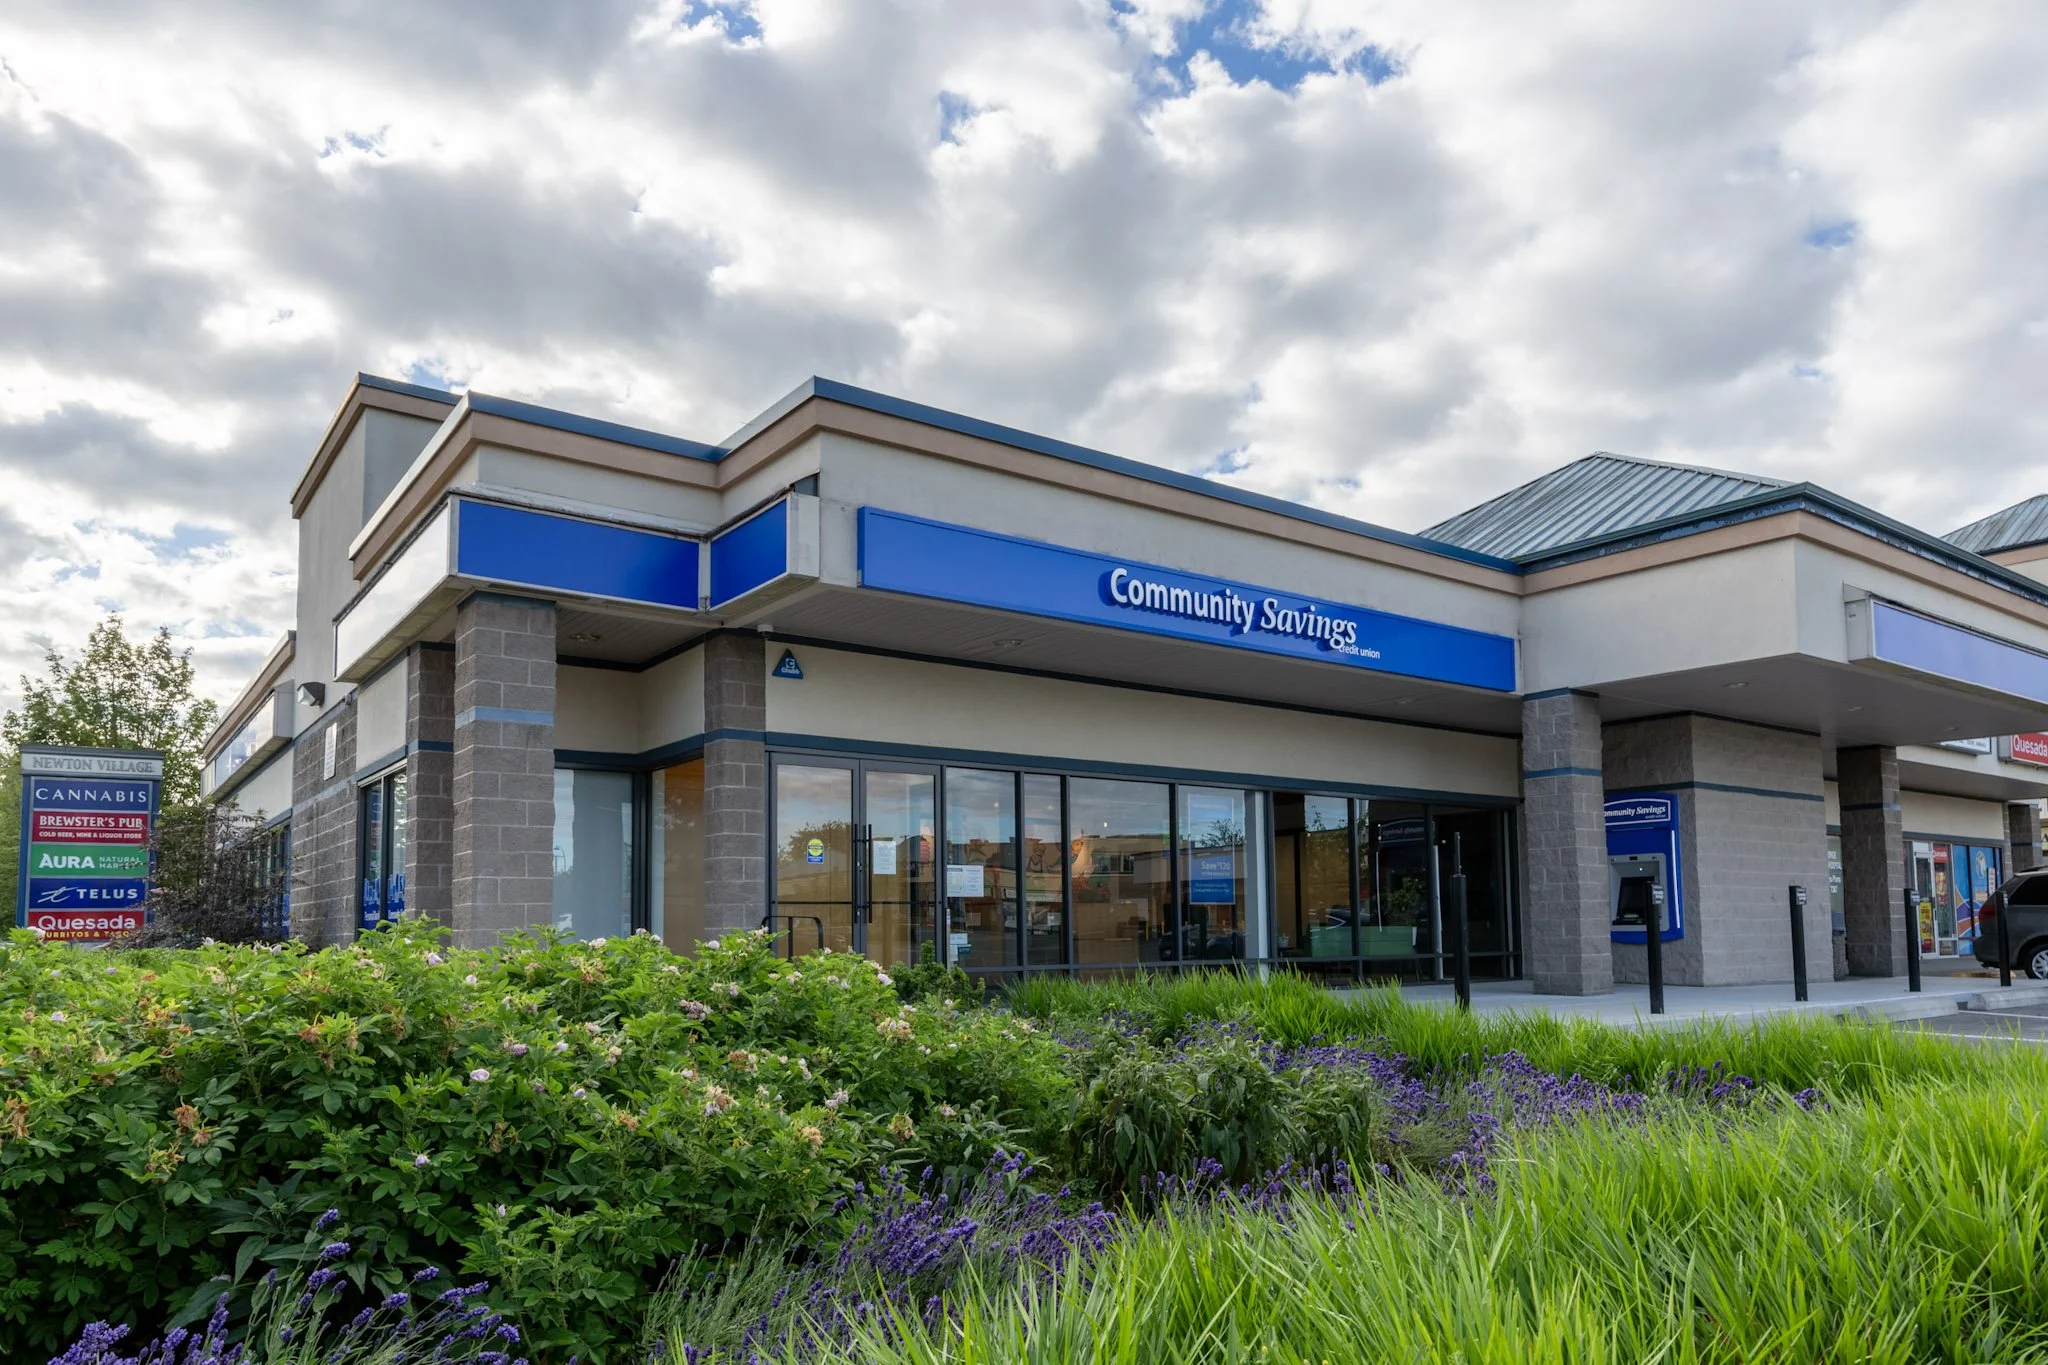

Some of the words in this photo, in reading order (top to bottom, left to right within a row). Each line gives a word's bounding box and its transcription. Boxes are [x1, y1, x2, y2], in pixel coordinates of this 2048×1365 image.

[1110, 567, 1255, 634] Community
[1260, 598, 1357, 650] Savings
[1338, 644, 1360, 656] credit
[1360, 647, 1381, 659] union
[2013, 734, 2048, 757] Quesada
[32, 756, 92, 771] NEWTON
[97, 759, 152, 773] VILLAGE
[35, 788, 147, 803] CANNABIS
[1603, 808, 1636, 817] ommunity
[1635, 805, 1666, 815] Savings
[40, 815, 115, 827] BREWSTER'S
[119, 818, 143, 828] PUB
[39, 853, 95, 869] AURA
[76, 888, 138, 899] TELUS
[38, 915, 136, 930] Quesada
